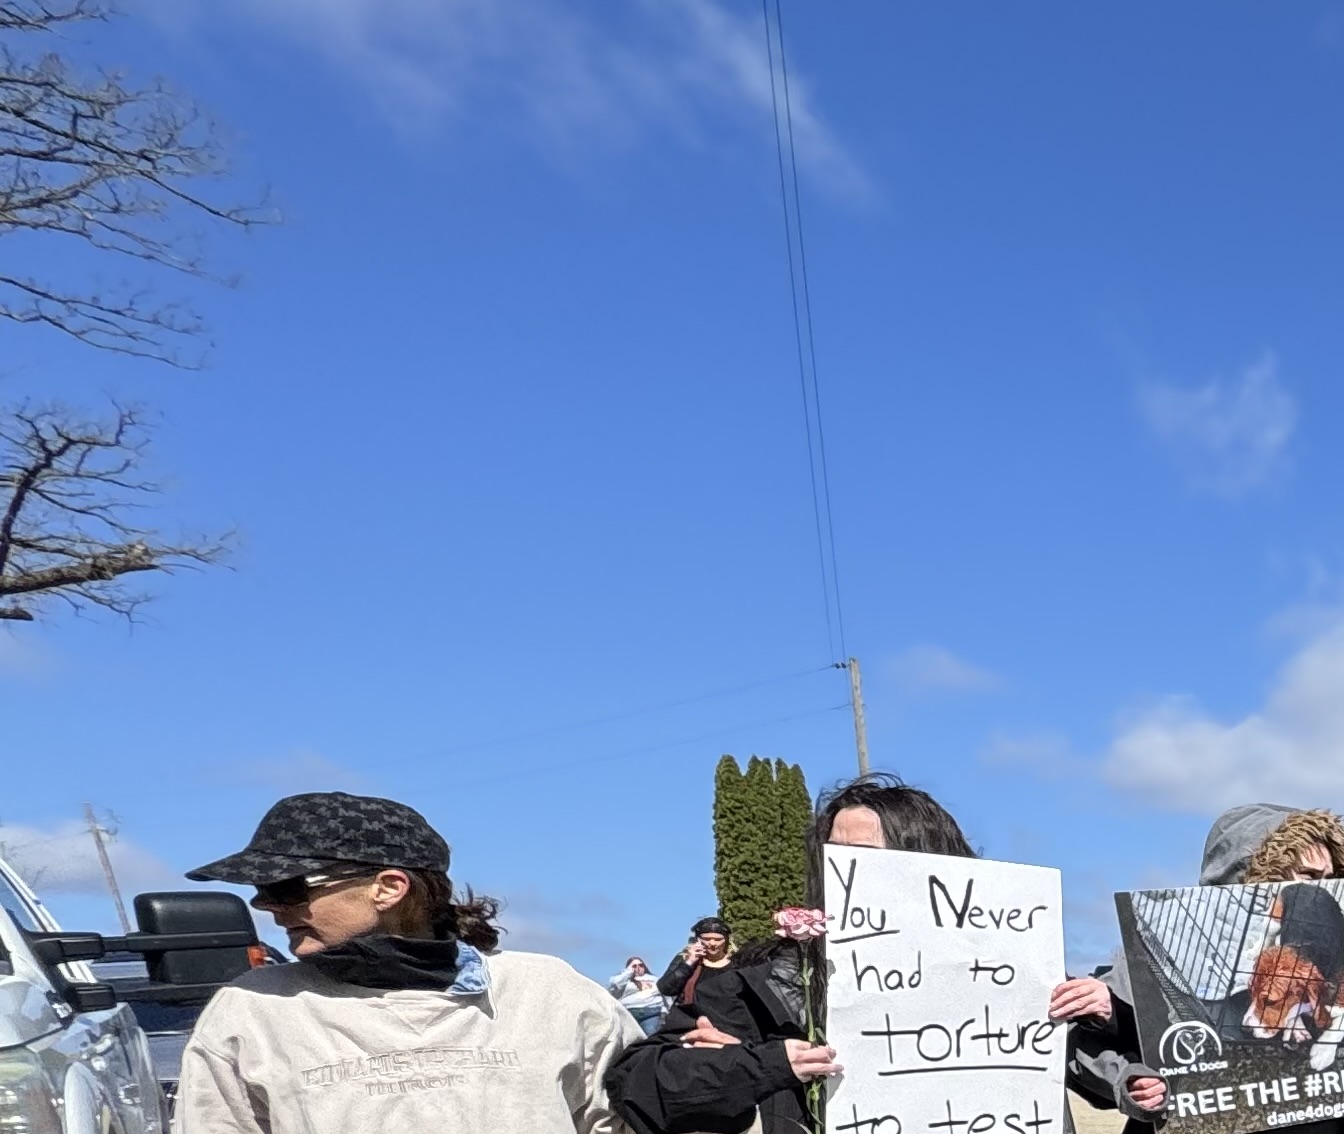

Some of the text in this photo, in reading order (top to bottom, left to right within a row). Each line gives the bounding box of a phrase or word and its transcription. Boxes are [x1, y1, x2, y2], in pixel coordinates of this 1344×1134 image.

[828, 857, 1048, 932] You Never
[852, 950, 1015, 992] had to
[861, 1004, 1056, 1064] torture
[1159, 1060, 1229, 1077] DANE 4 DOGS
[1239, 1077, 1300, 1105] THE
